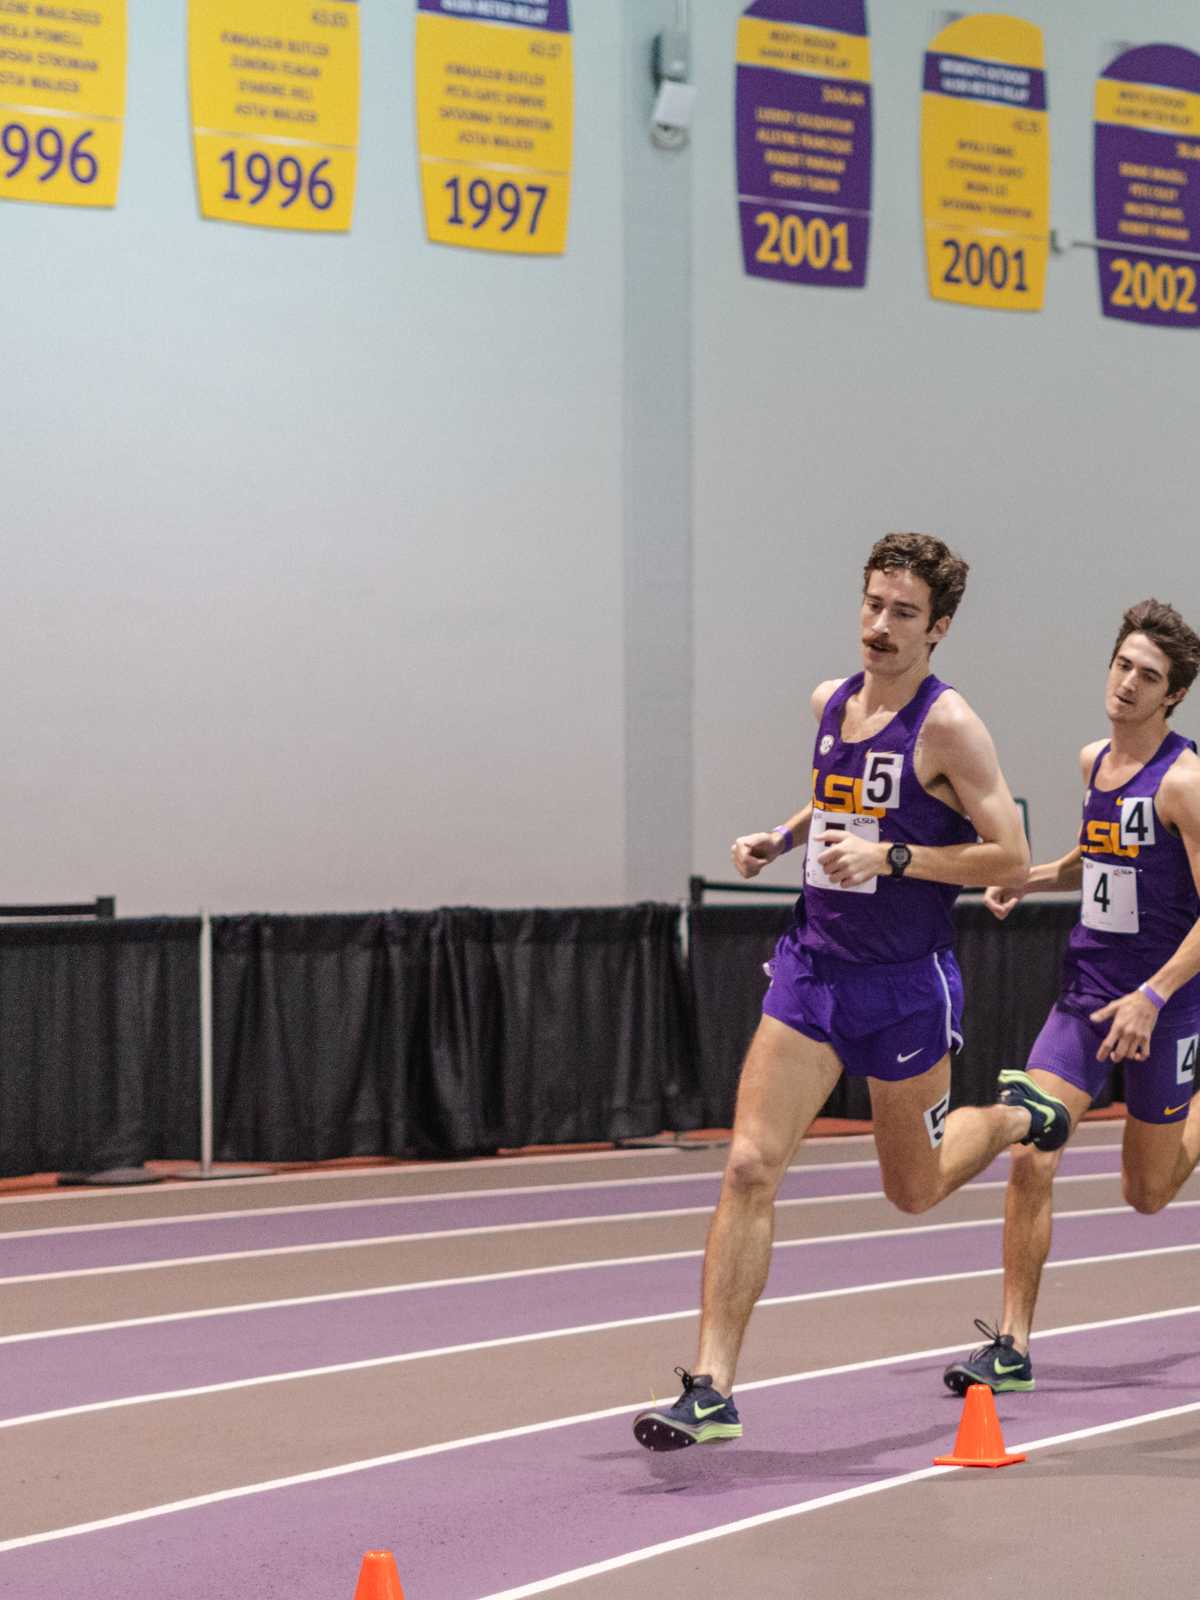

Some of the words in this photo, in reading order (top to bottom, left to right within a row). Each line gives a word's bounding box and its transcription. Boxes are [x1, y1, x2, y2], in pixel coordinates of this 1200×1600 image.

[219, 149, 335, 211] 1996
[444, 176, 549, 236] 1997
[755, 211, 852, 272] 2001
[941, 238, 1029, 293] 2001
[1110, 258, 1198, 314] 2002
[867, 757, 894, 803] 5
[1080, 820, 1140, 858] SU
[1125, 801, 1149, 842] 4
[1093, 872, 1111, 913] 4
